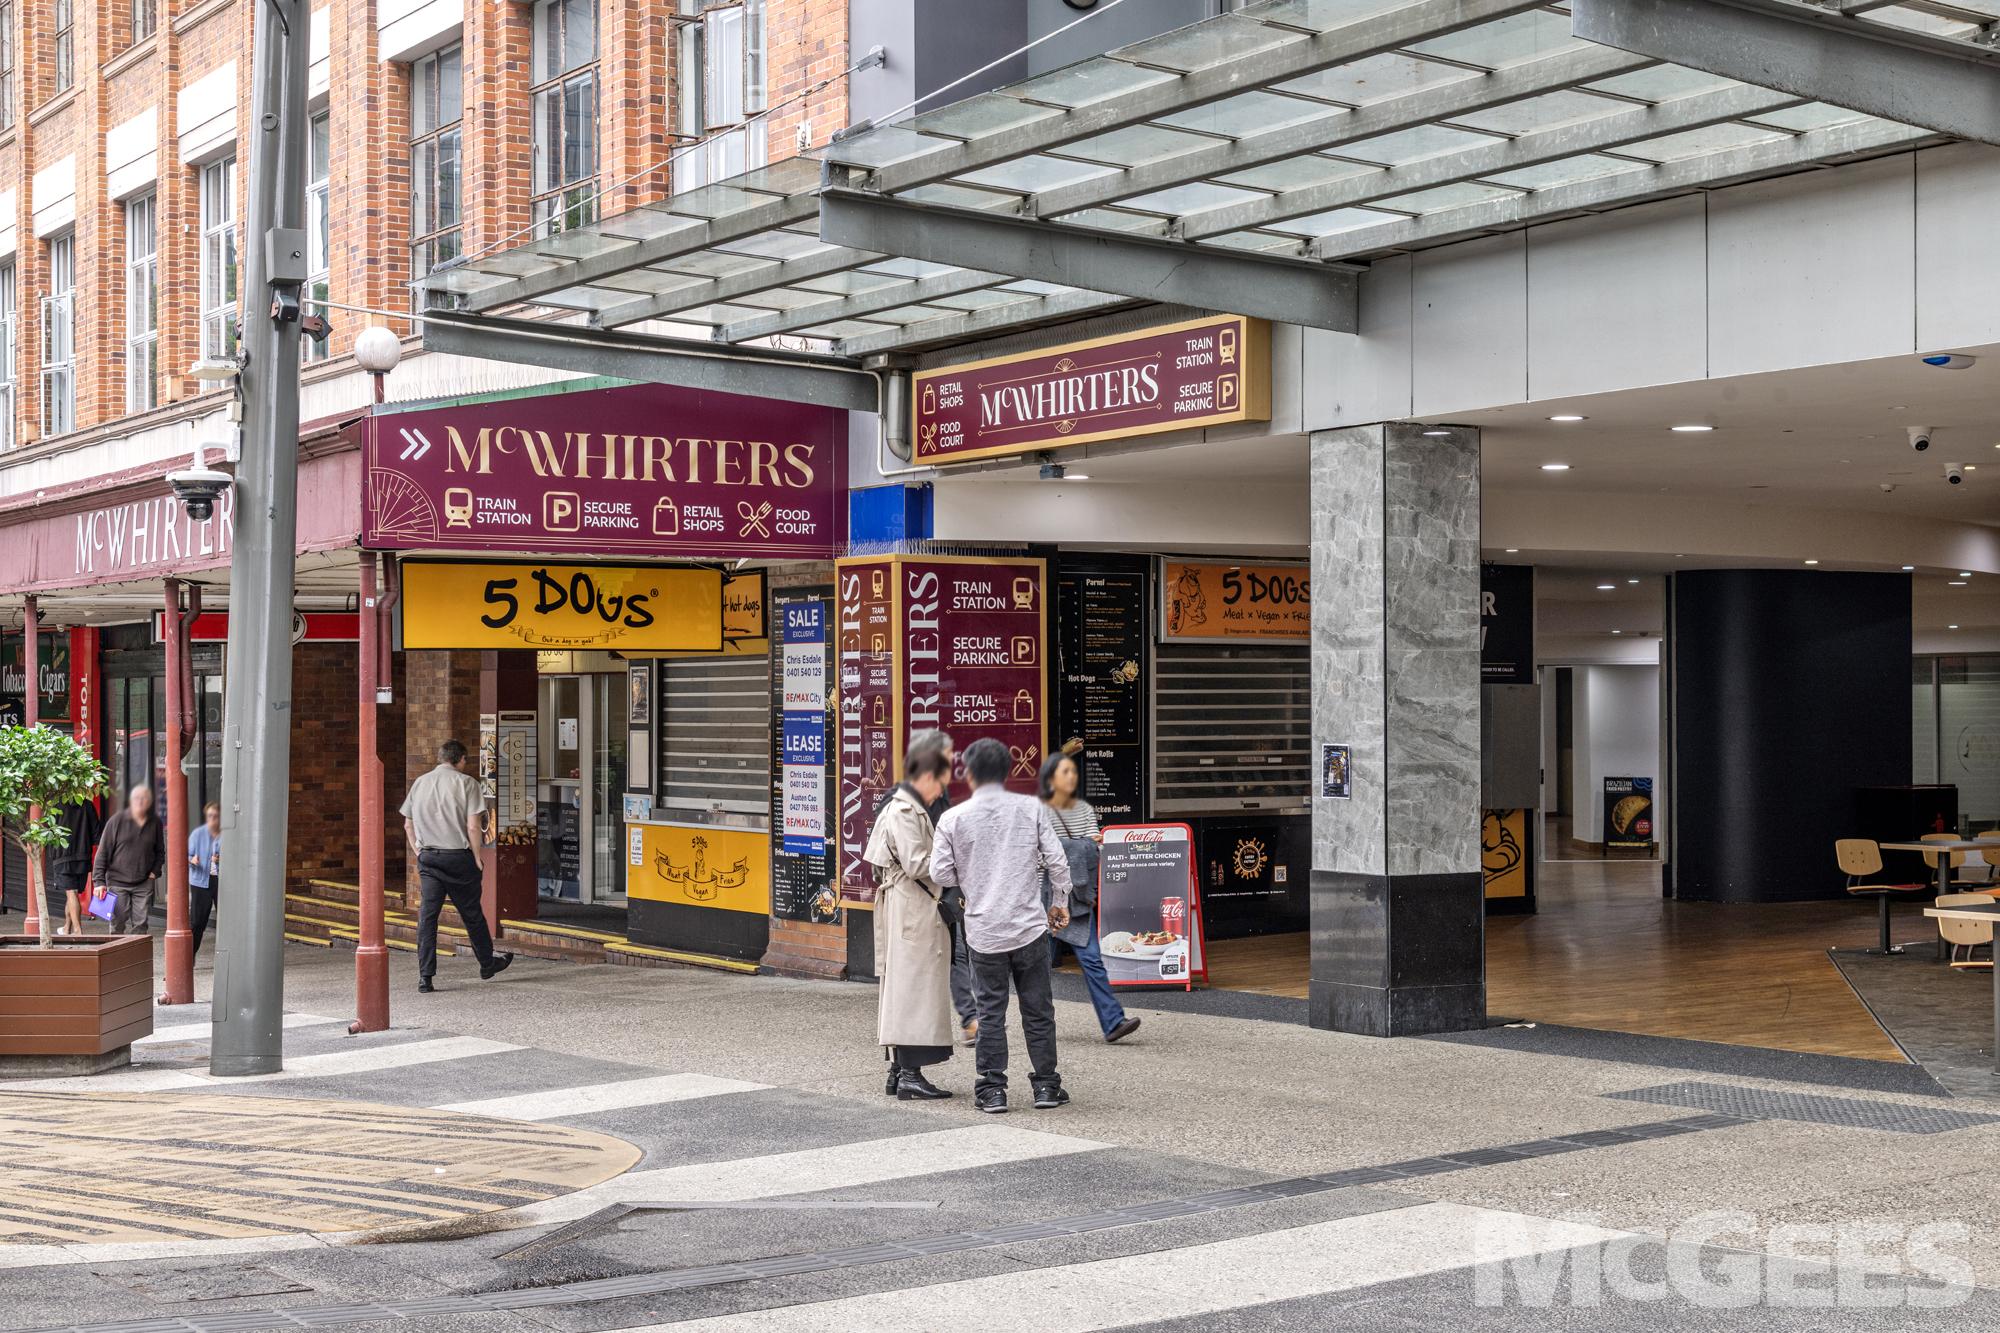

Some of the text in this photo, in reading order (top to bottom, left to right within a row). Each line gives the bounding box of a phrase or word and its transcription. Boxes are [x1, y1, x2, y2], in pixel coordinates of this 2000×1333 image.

[1186, 336, 1213, 352] TRAIN
[1176, 351, 1213, 369] STATION
[940, 382, 963, 395] RETAIL
[1180, 380, 1213, 398] SECURE
[940, 395, 964, 409] SHOPS
[1174, 395, 1213, 414] PARKING
[940, 421, 961, 434] FOOD
[940, 434, 964, 447] COURT
[476, 497, 516, 511] TRAIN
[584, 502, 632, 515] SECURE
[476, 511, 531, 525] STATION
[684, 505, 723, 519] RETAIL
[776, 509, 811, 521] FOOD
[584, 516, 639, 529] PARKING
[684, 519, 724, 531] SHOPS
[776, 522, 816, 535] COURT
[953, 581, 991, 595] TRAIN
[1222, 570, 1241, 605] 5
[481, 578, 519, 629] 5
[730, 593, 742, 612] hot
[743, 594, 760, 618] dogs
[953, 597, 1006, 610] STATION
[789, 608, 818, 627] SALE
[872, 607, 885, 615] TRAIN
[1223, 608, 1244, 620] Meat
[1256, 609, 1280, 624] Vegan
[1292, 611, 1311, 621] Frie
[869, 616, 888, 624] STATION
[792, 631, 815, 639] EXCLUSIVE
[953, 637, 1001, 651] SECURE
[787, 655, 821, 665] Chris Esdale
[953, 652, 1010, 666] PARKING
[787, 668, 821, 677] 0401 540 129
[870, 669, 887, 677] SECURE
[1068, 674, 1096, 684] Hot Dogs
[40, 664, 65, 703] Cigars
[869, 678, 888, 686] PARKING
[953, 695, 994, 708] RETAIL
[953, 710, 997, 723] SHOPS
[872, 731, 886, 740] RETAIL
[786, 735, 821, 751] LEASE
[872, 741, 887, 749] SHOPS
[513, 740, 522, 814] COFFEE
[790, 771, 818, 780] Chris Esdale
[1112, 805, 1131, 813] Garlic
[1130, 852, 1153, 860] BUTTER
[693, 884, 709, 899] Vegan
